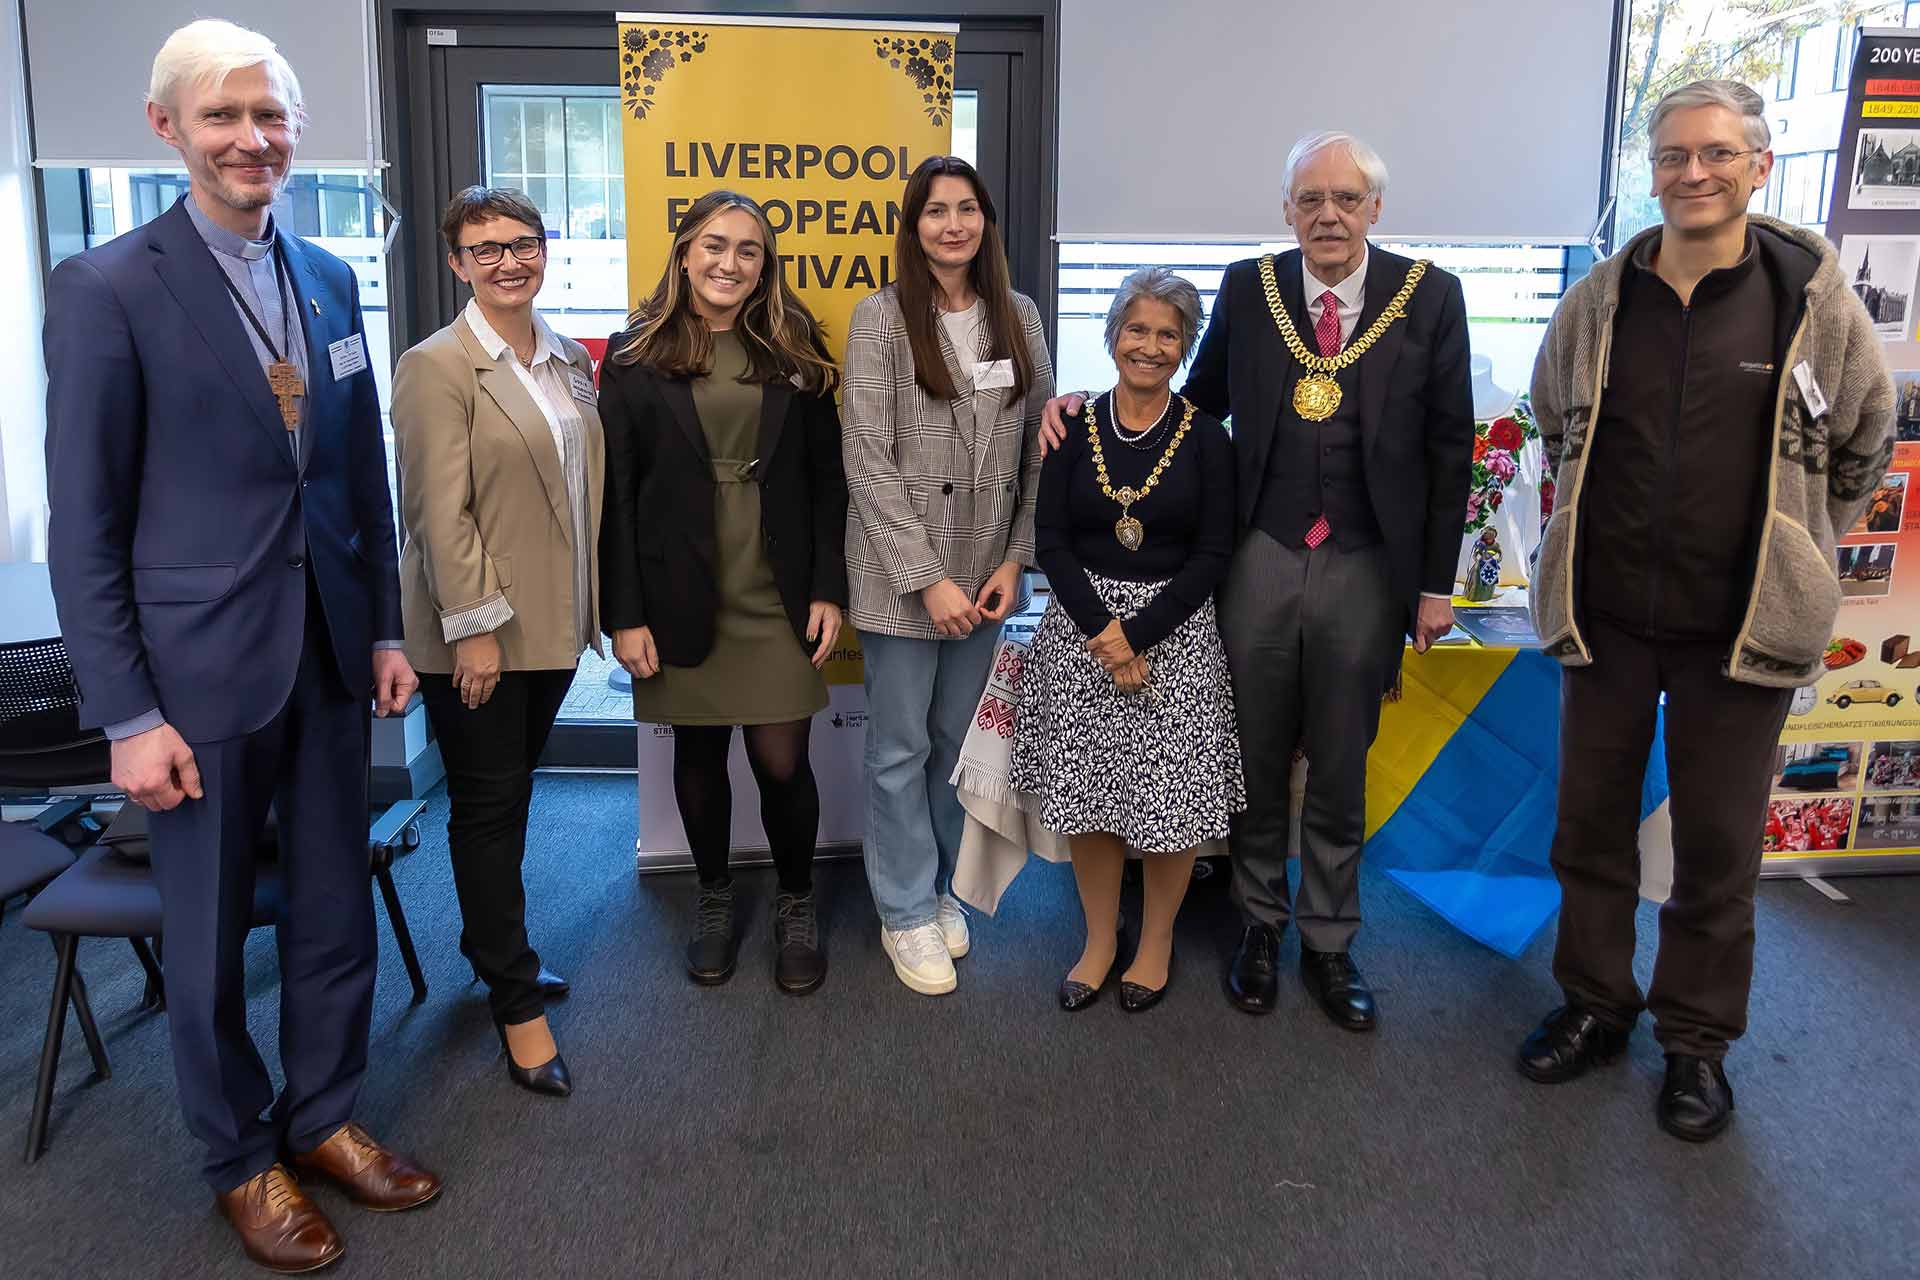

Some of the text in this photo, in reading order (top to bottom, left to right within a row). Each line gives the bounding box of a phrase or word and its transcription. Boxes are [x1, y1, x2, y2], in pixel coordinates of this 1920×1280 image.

[1869, 47, 1901, 64] 200
[664, 142, 912, 181] LIVERPOOL
[667, 198, 903, 236] EOPEAN
[777, 254, 890, 289] TIVAL
